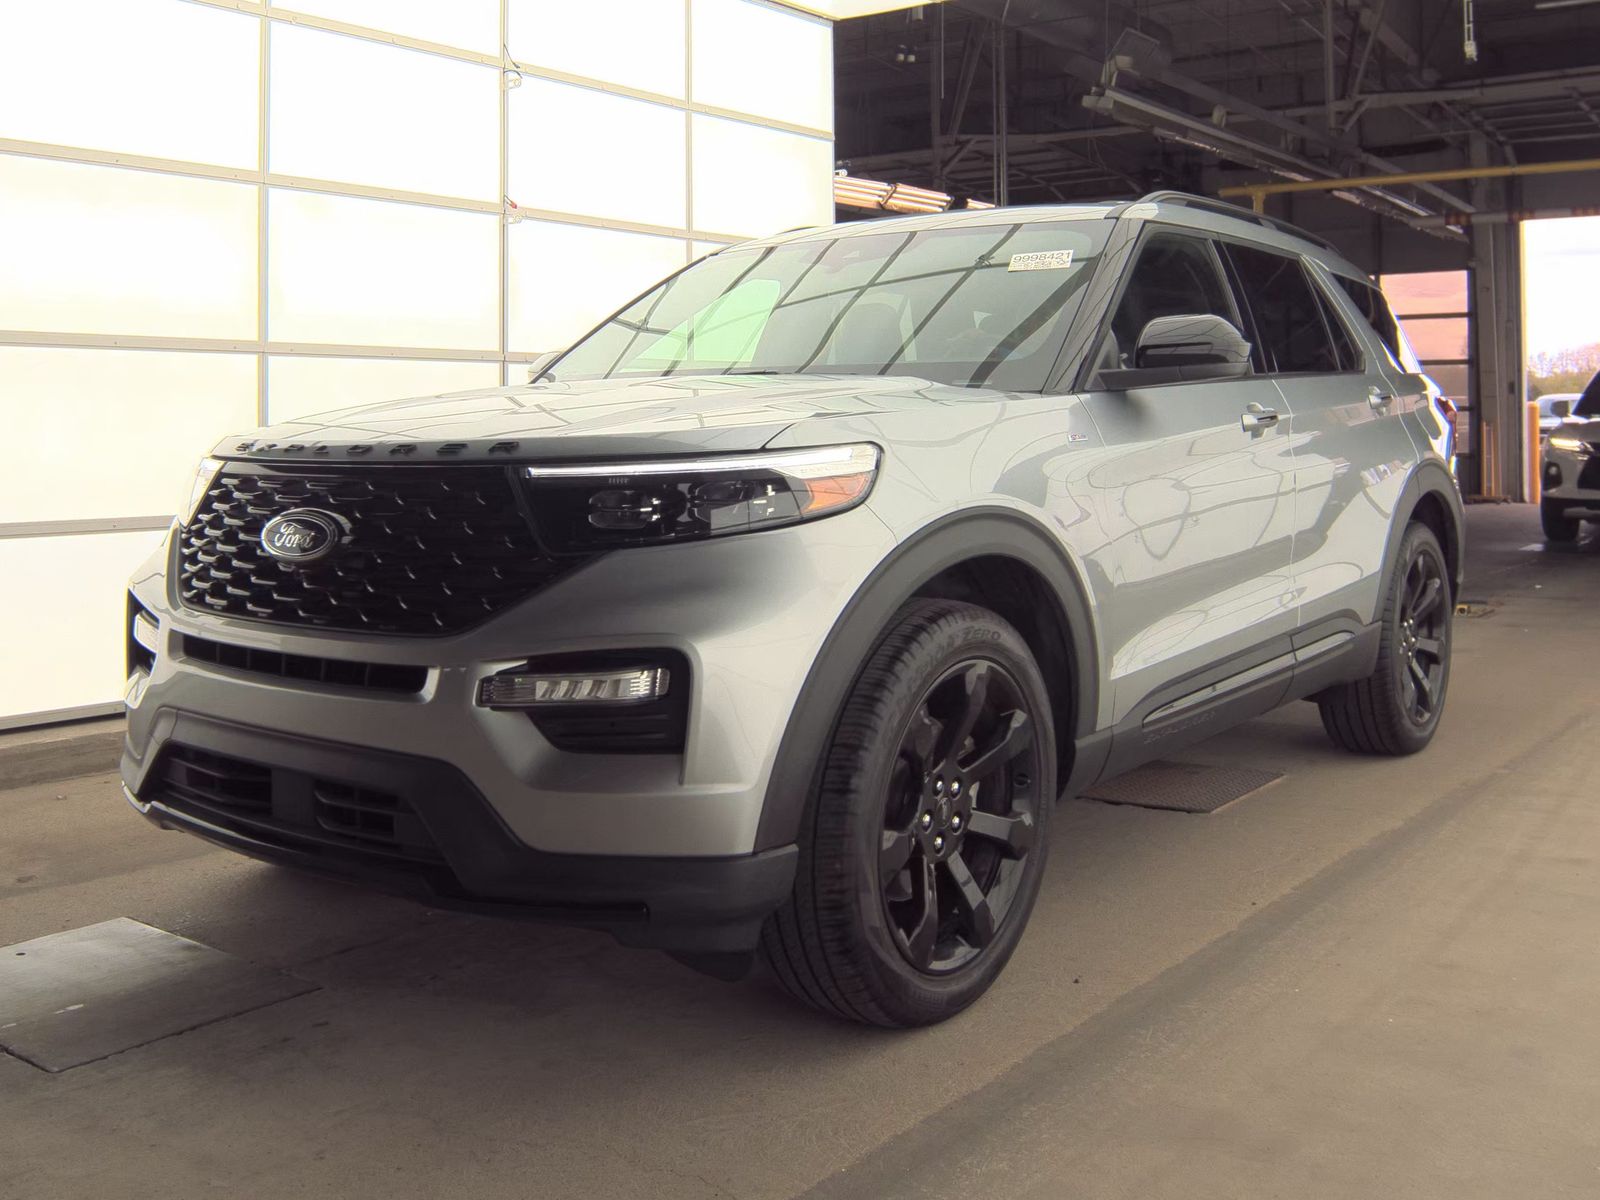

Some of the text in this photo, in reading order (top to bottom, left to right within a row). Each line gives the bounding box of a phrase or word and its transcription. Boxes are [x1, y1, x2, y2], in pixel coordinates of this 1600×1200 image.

[1013, 252, 1070, 263] 9998421
[274, 521, 317, 548] Ford
[963, 625, 1002, 641] ZERO
